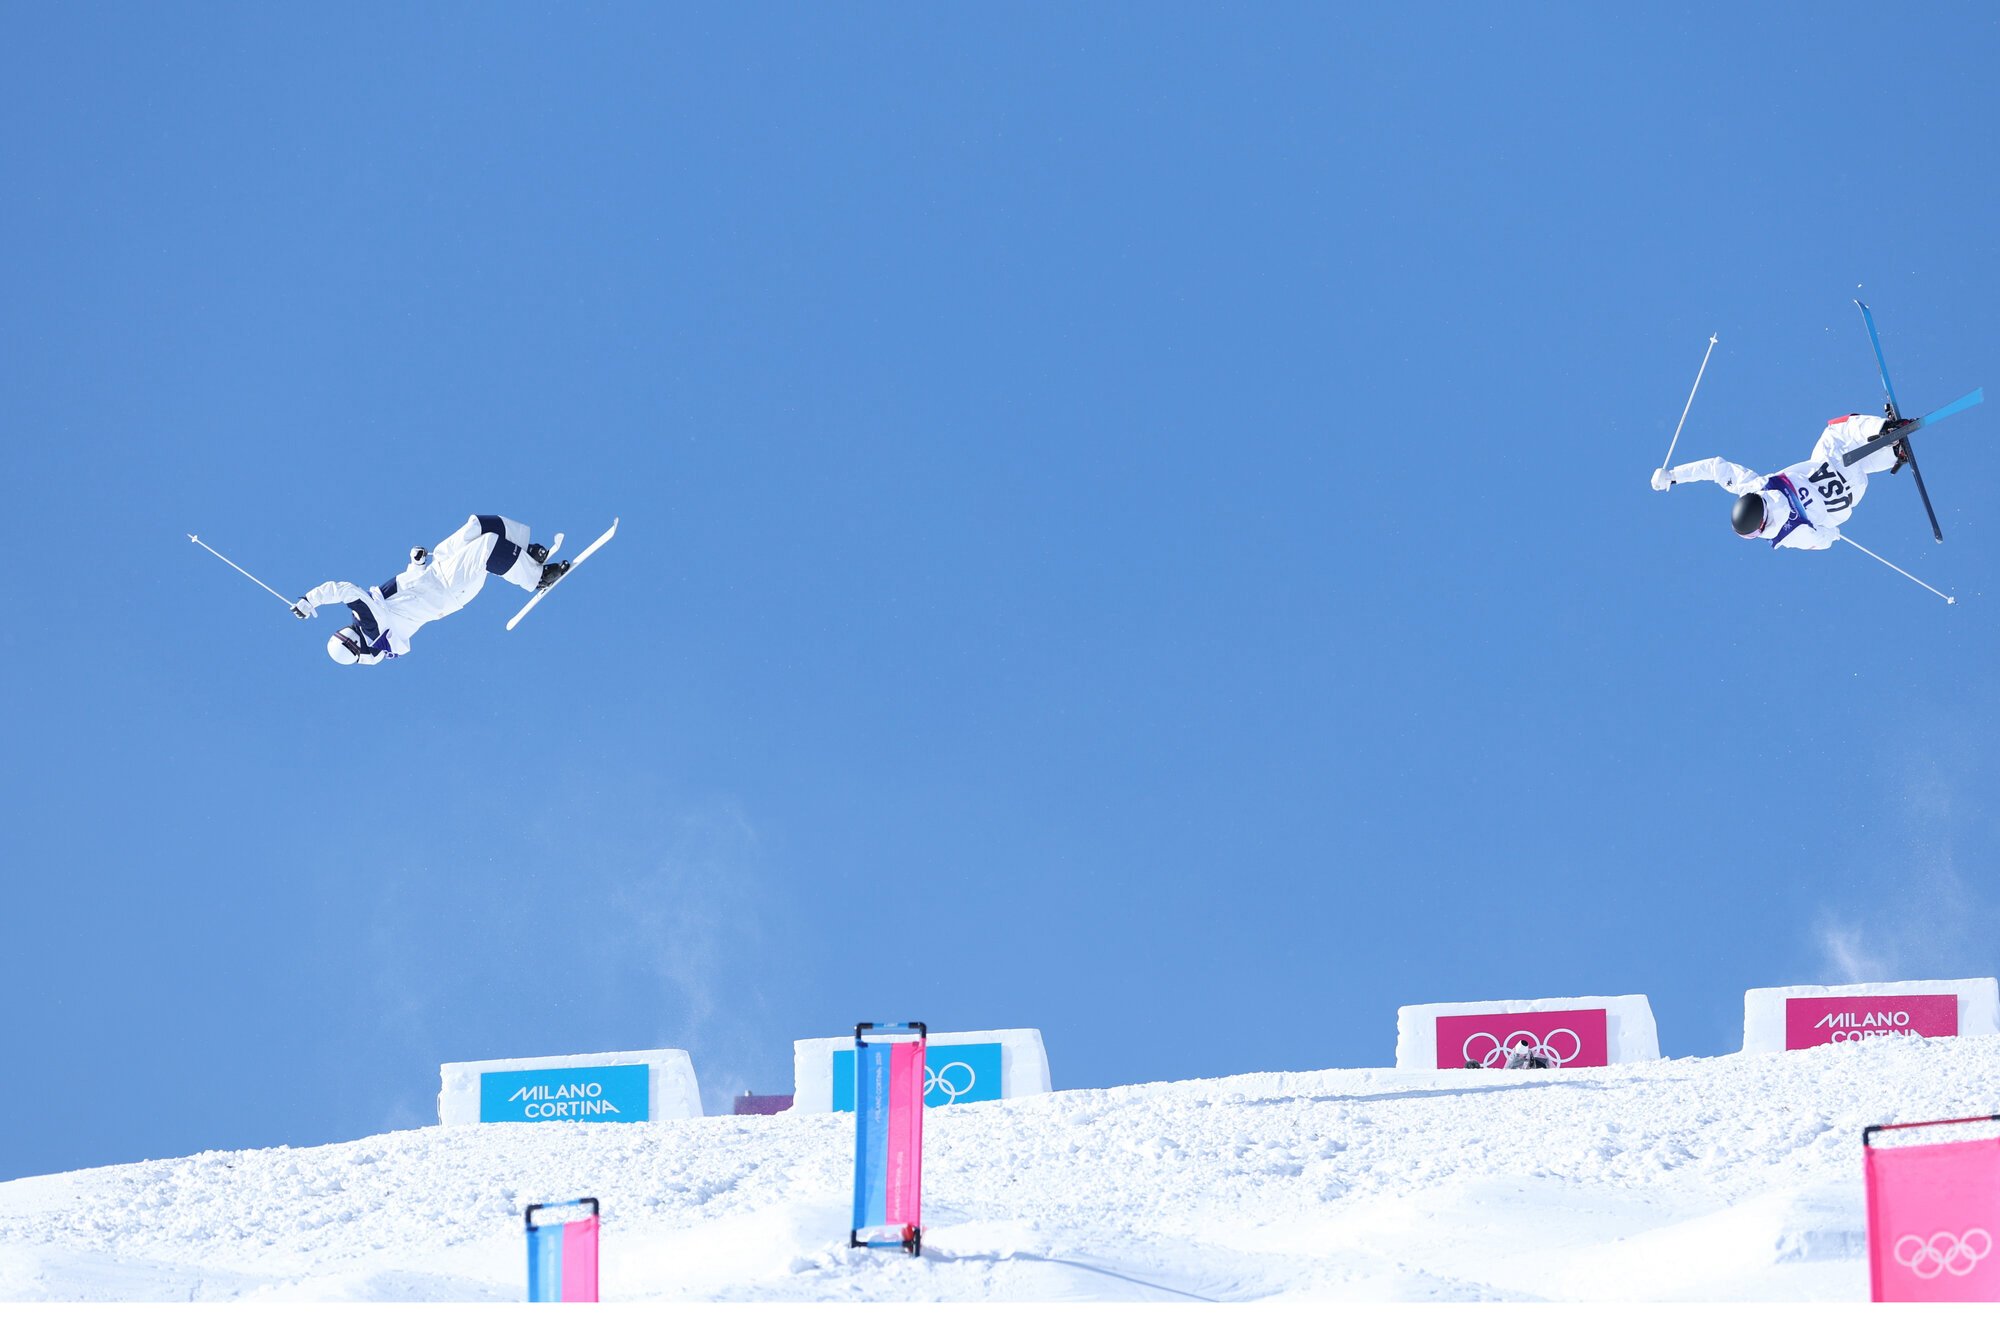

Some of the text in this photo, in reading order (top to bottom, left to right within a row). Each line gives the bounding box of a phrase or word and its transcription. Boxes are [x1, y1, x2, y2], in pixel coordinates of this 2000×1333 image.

[1808, 461, 1851, 512] USA
[1798, 487, 1814, 510] 15
[1813, 1011, 1910, 1029] MILANO
[508, 1082, 602, 1102] MILANO
[525, 1099, 620, 1118] CORTINA
